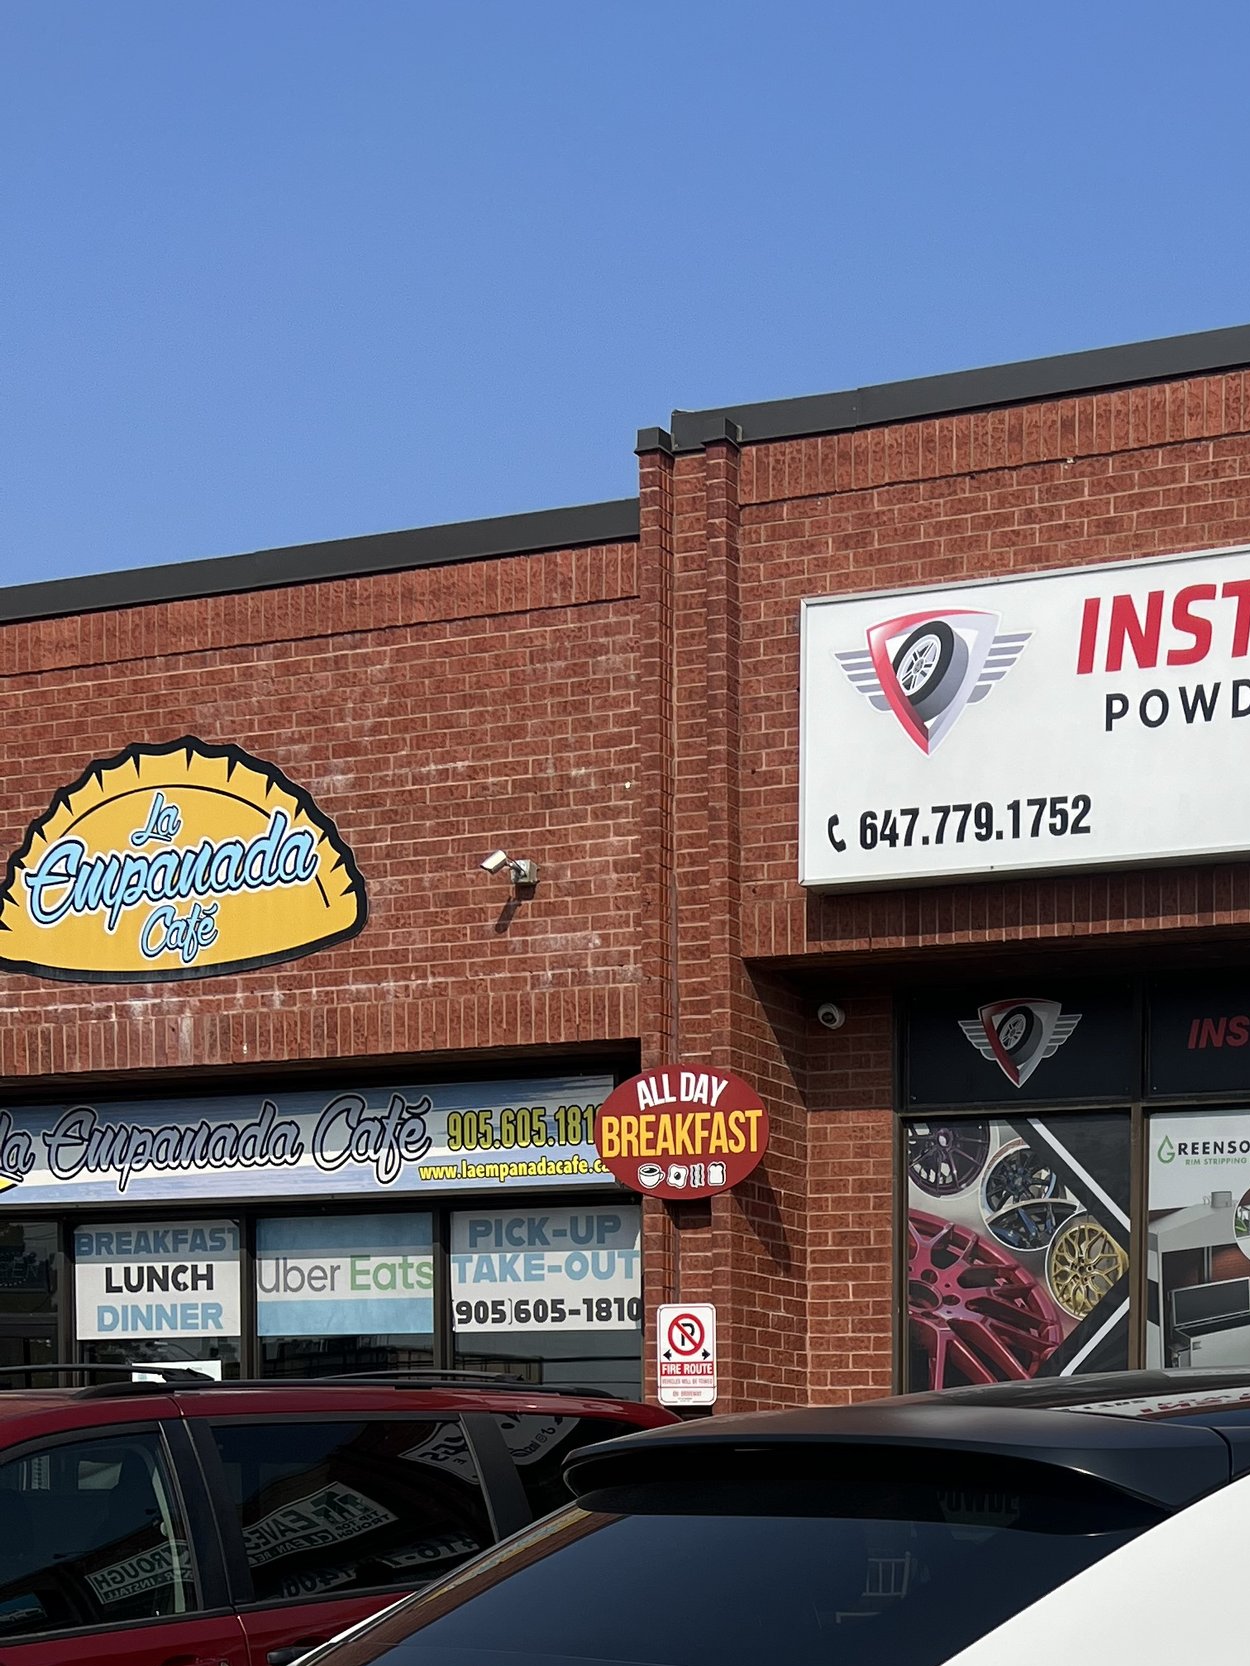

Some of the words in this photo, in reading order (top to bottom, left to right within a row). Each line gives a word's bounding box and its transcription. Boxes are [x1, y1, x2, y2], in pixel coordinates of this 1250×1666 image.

[131, 793, 180, 843] La
[859, 794, 1092, 850] 647.779.1752
[26, 811, 318, 928] Empanada
[141, 905, 217, 962] Café
[636, 1074, 676, 1111] ALL
[680, 1072, 728, 1107] DAY
[42, 1100, 304, 1192] Empanada
[312, 1093, 433, 1184] Café
[447, 1103, 603, 1150] 905.605.181
[602, 1109, 763, 1158] BREAKFAST
[1185, 1158, 1201, 1166] RIM
[1204, 1157, 1247, 1165] STRIPPING
[468, 1214, 622, 1249] PICK-UP
[105, 1264, 214, 1294] LUNCH
[257, 1258, 341, 1293] Uber
[350, 1255, 434, 1291] Eats
[451, 1250, 640, 1284] TAKE-OUT
[97, 1302, 223, 1332] DINNER
[661, 1363, 682, 1375] FIRE
[683, 1363, 713, 1375] ROUTE
